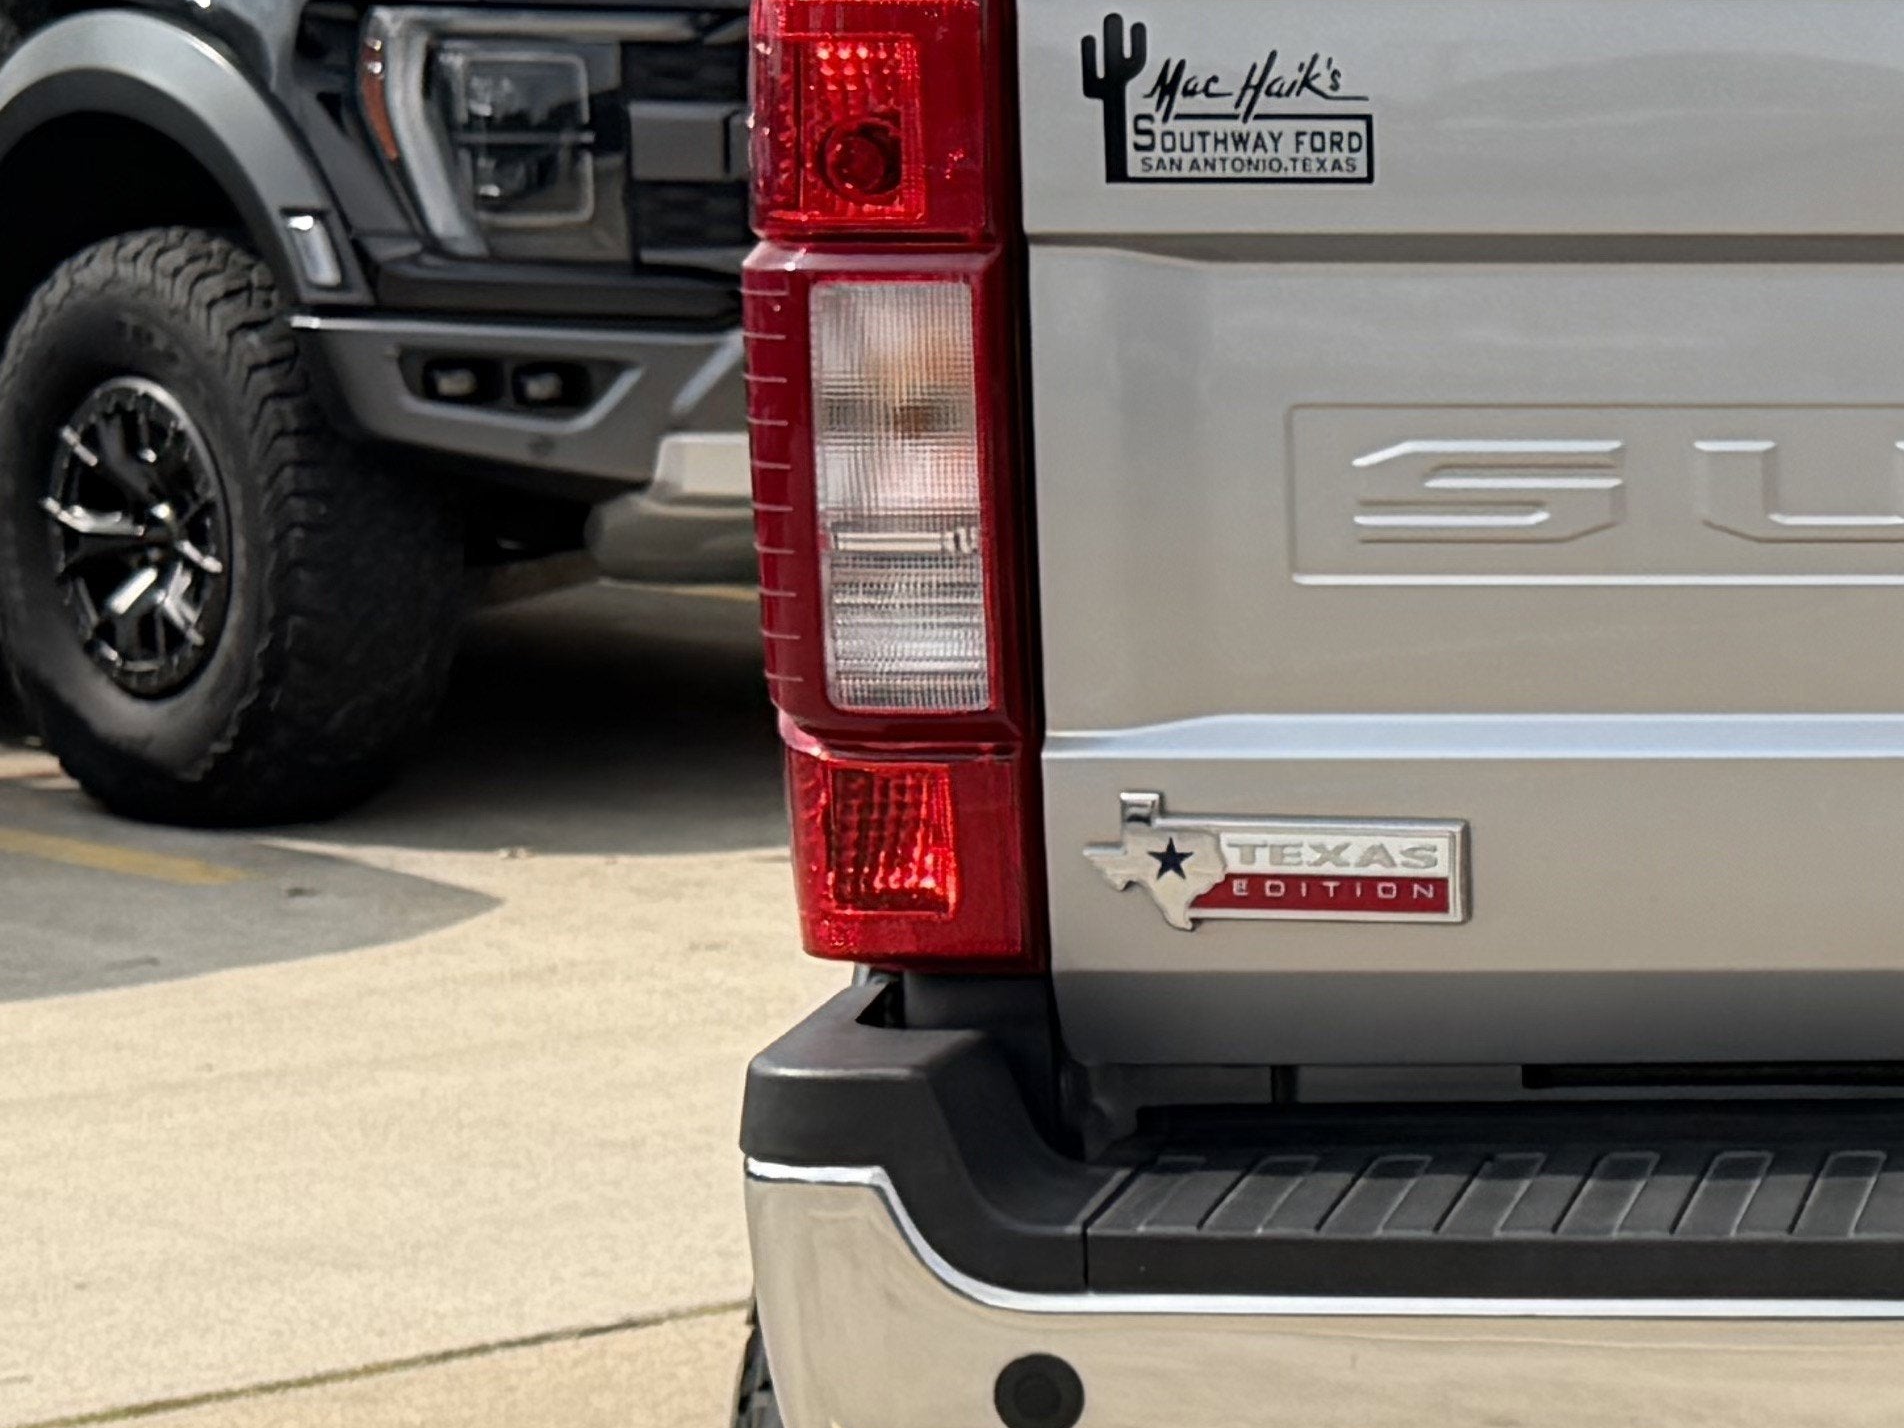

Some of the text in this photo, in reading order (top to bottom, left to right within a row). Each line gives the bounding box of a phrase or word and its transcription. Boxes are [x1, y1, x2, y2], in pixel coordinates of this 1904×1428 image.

[1143, 49, 1369, 124] Mac Haik's
[1133, 113, 1363, 153] SOUTHWAY FORD
[1142, 157, 1183, 173] SAN
[1226, 843, 1438, 869] TEXAS
[1232, 880, 1434, 898] EDITION
